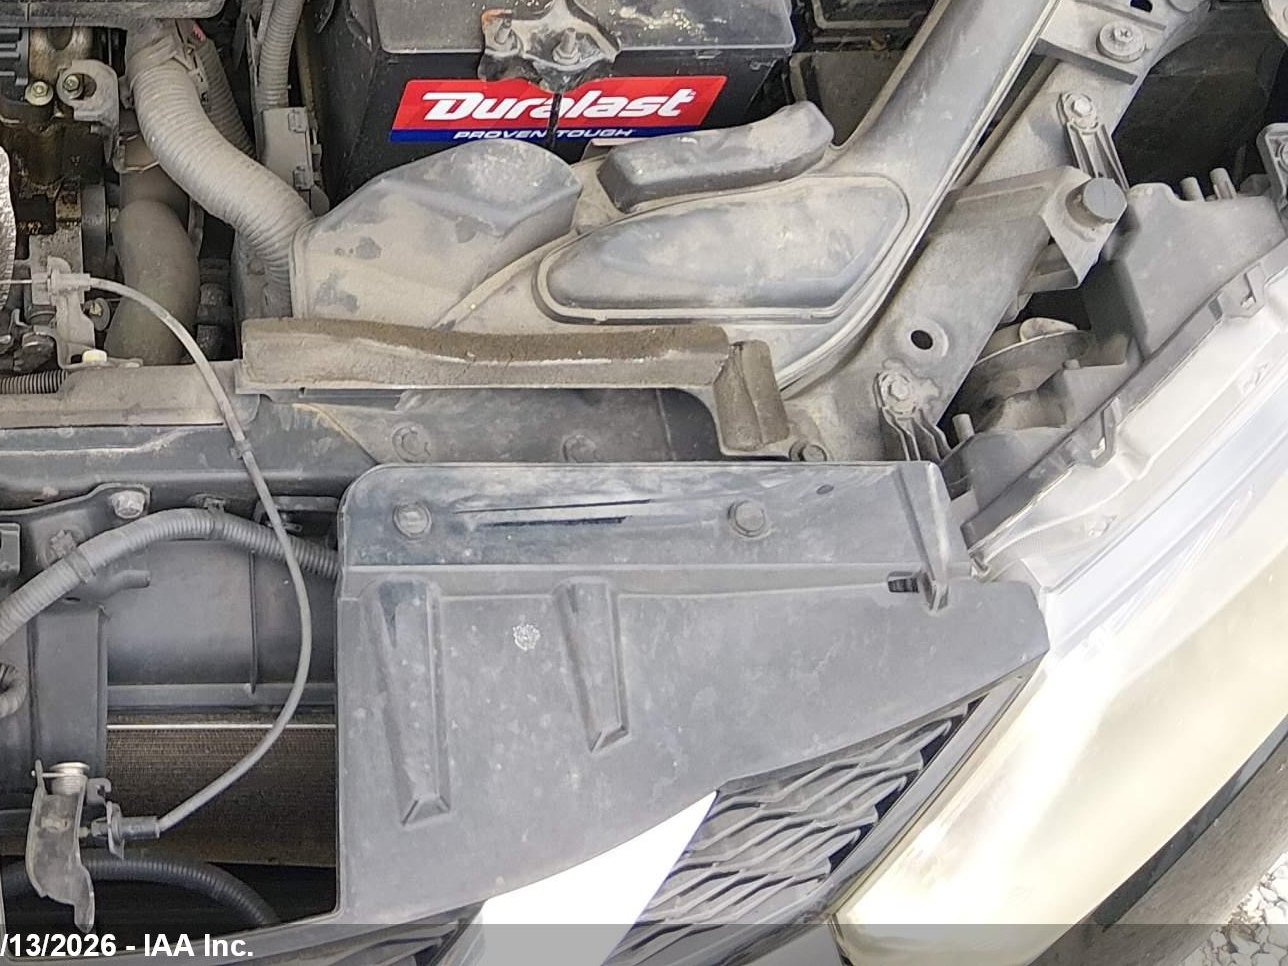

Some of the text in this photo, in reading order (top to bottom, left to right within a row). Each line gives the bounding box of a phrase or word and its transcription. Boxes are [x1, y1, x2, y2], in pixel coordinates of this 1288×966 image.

[422, 88, 697, 121] Duralast
[453, 128, 633, 140] PROVEN TOUGH
